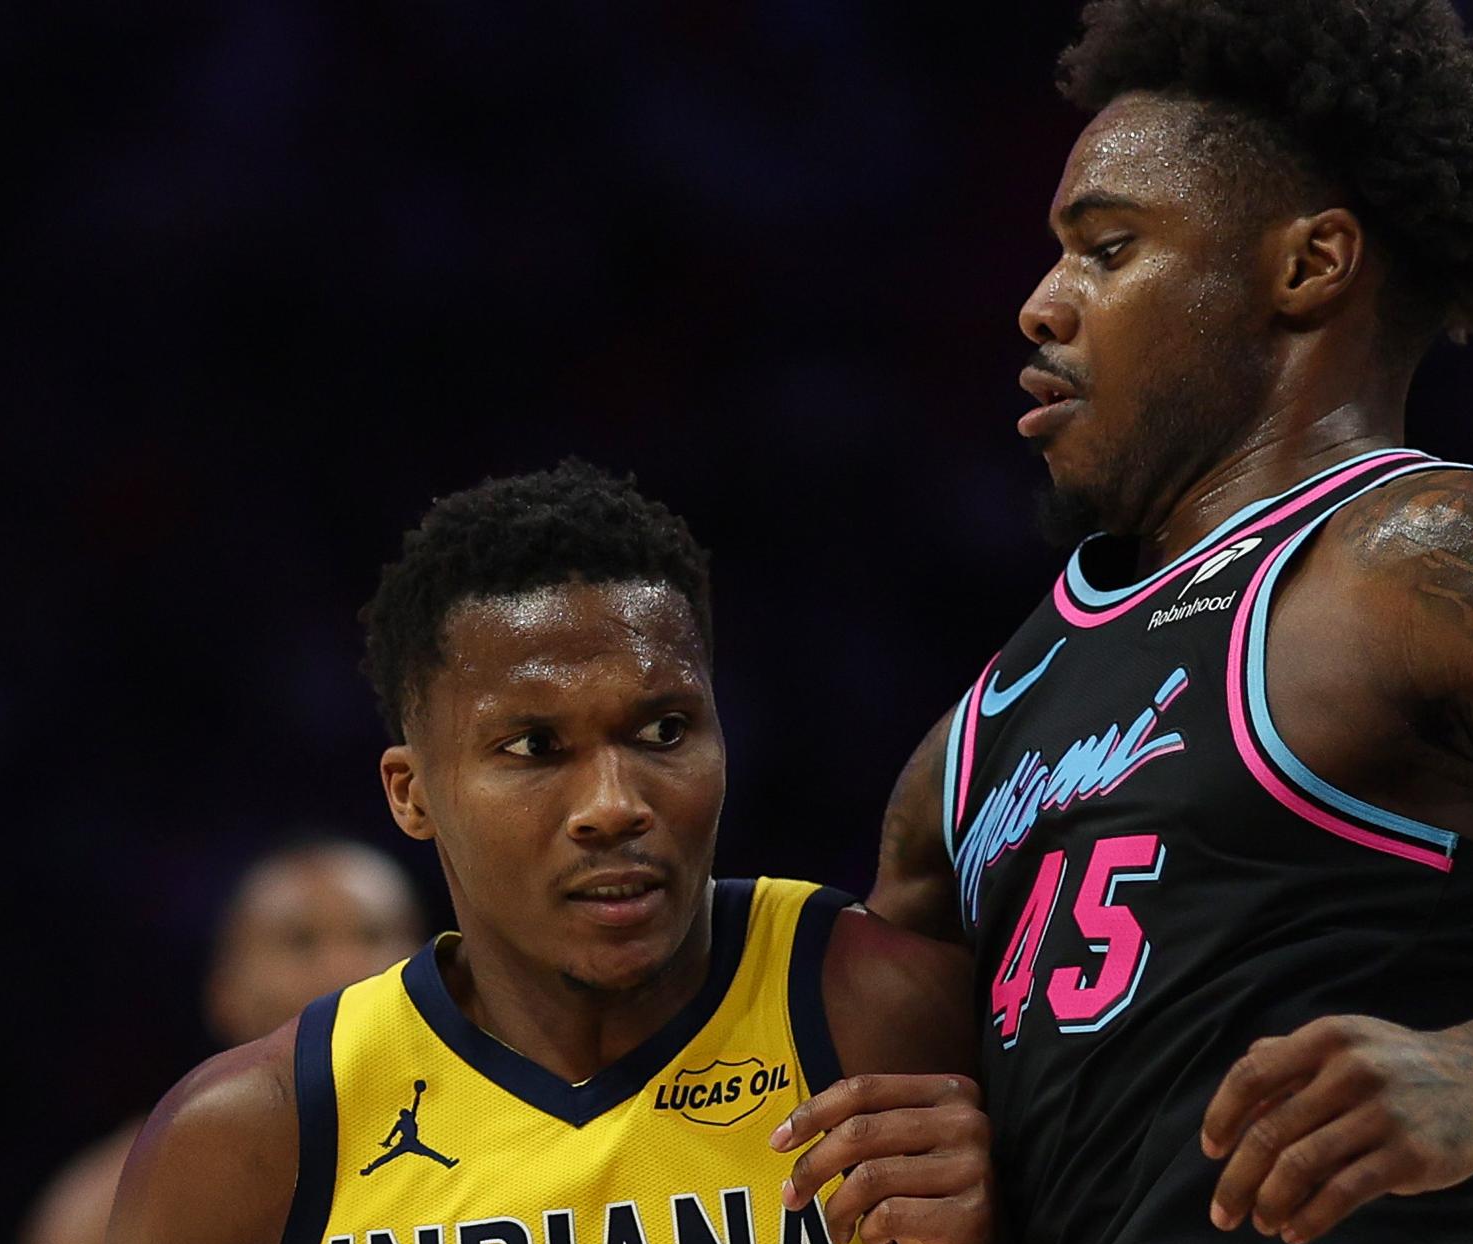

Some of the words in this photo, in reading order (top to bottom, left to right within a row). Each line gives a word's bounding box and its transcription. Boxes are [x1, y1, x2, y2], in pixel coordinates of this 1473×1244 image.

[1147, 590, 1237, 631] Robinhood
[954, 667, 1189, 930] Miami
[992, 834, 1166, 1050] 45
[654, 1076, 742, 1110] LUCAS
[749, 1064, 790, 1096] OIL
